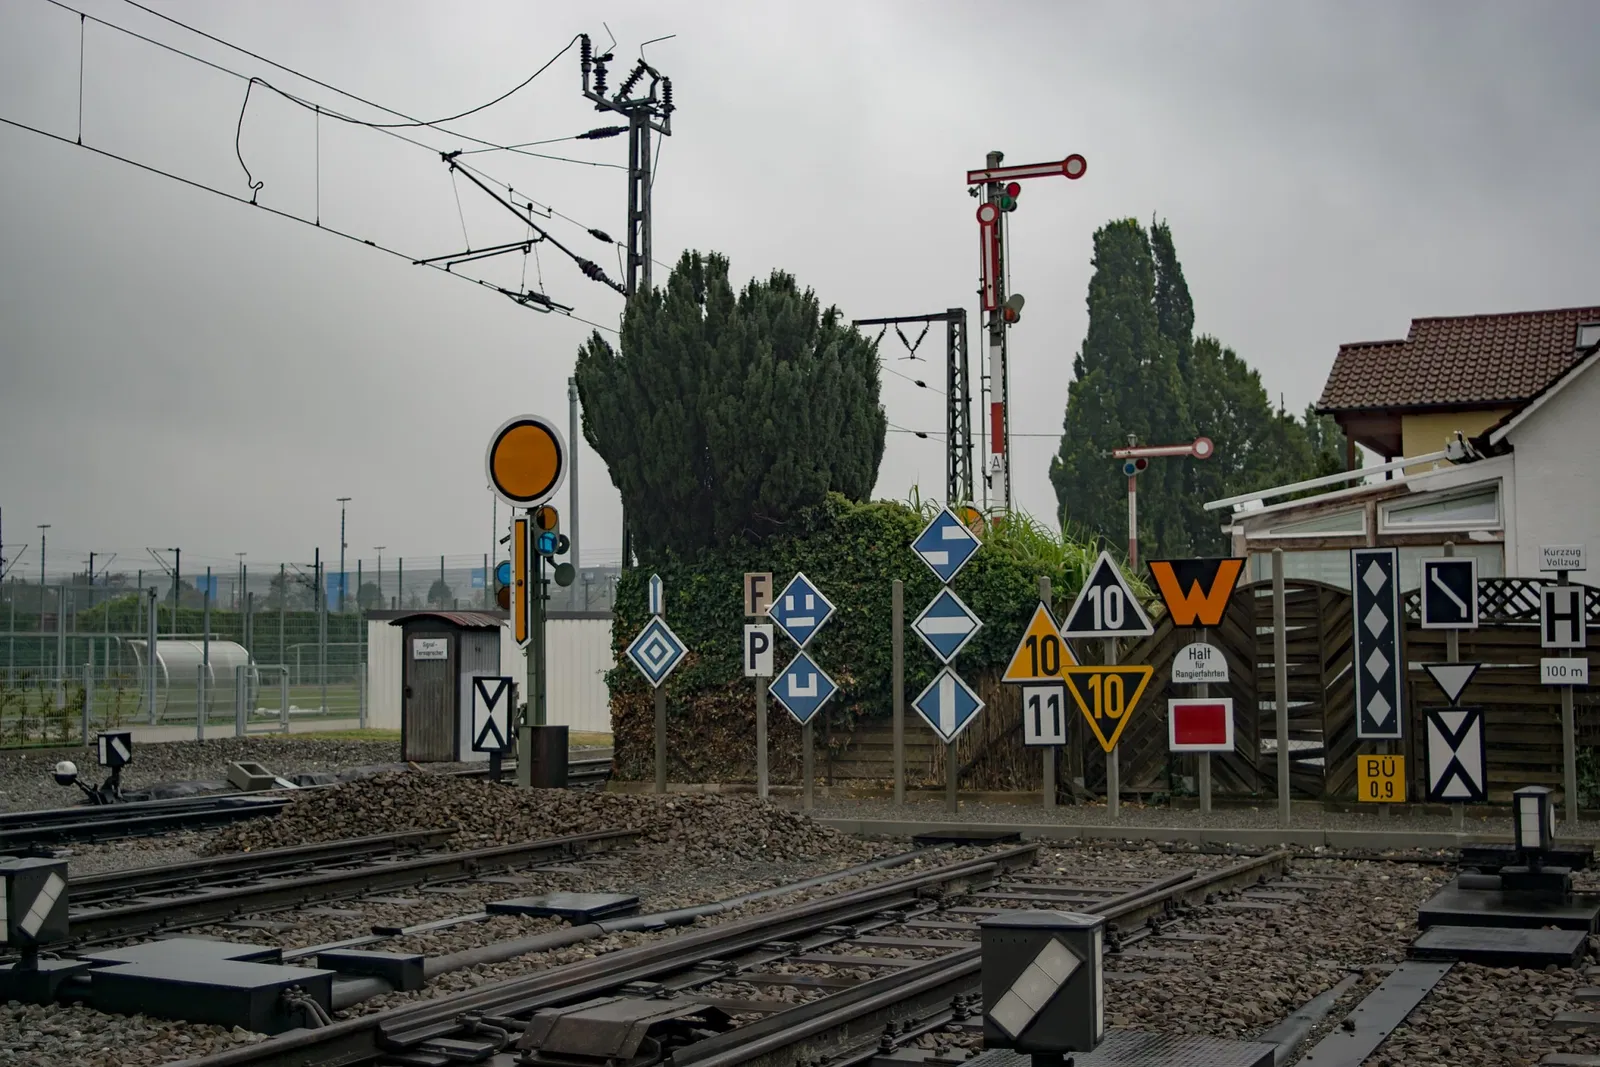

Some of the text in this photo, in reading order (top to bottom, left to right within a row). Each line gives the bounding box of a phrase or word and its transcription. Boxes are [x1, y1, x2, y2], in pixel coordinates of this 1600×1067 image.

[992, 455, 1001, 469] A
[1544, 548, 1581, 558] Kurzzug
[1546, 558, 1580, 567] Vollzug
[751, 576, 765, 613] F
[1149, 561, 1243, 625] W
[1087, 584, 1124, 631] 10
[1546, 592, 1580, 642] H
[750, 631, 769, 670] P
[1025, 634, 1060, 677] 10
[1189, 647, 1211, 660] Halt
[1175, 670, 1225, 680] Rangierfahrten
[1195, 661, 1205, 669] für
[1546, 666, 1583, 677] 100 m
[1087, 673, 1124, 719] 10
[1028, 694, 1060, 737] 11
[1367, 755, 1396, 778] BÜ
[1369, 781, 1394, 802] 0,9
